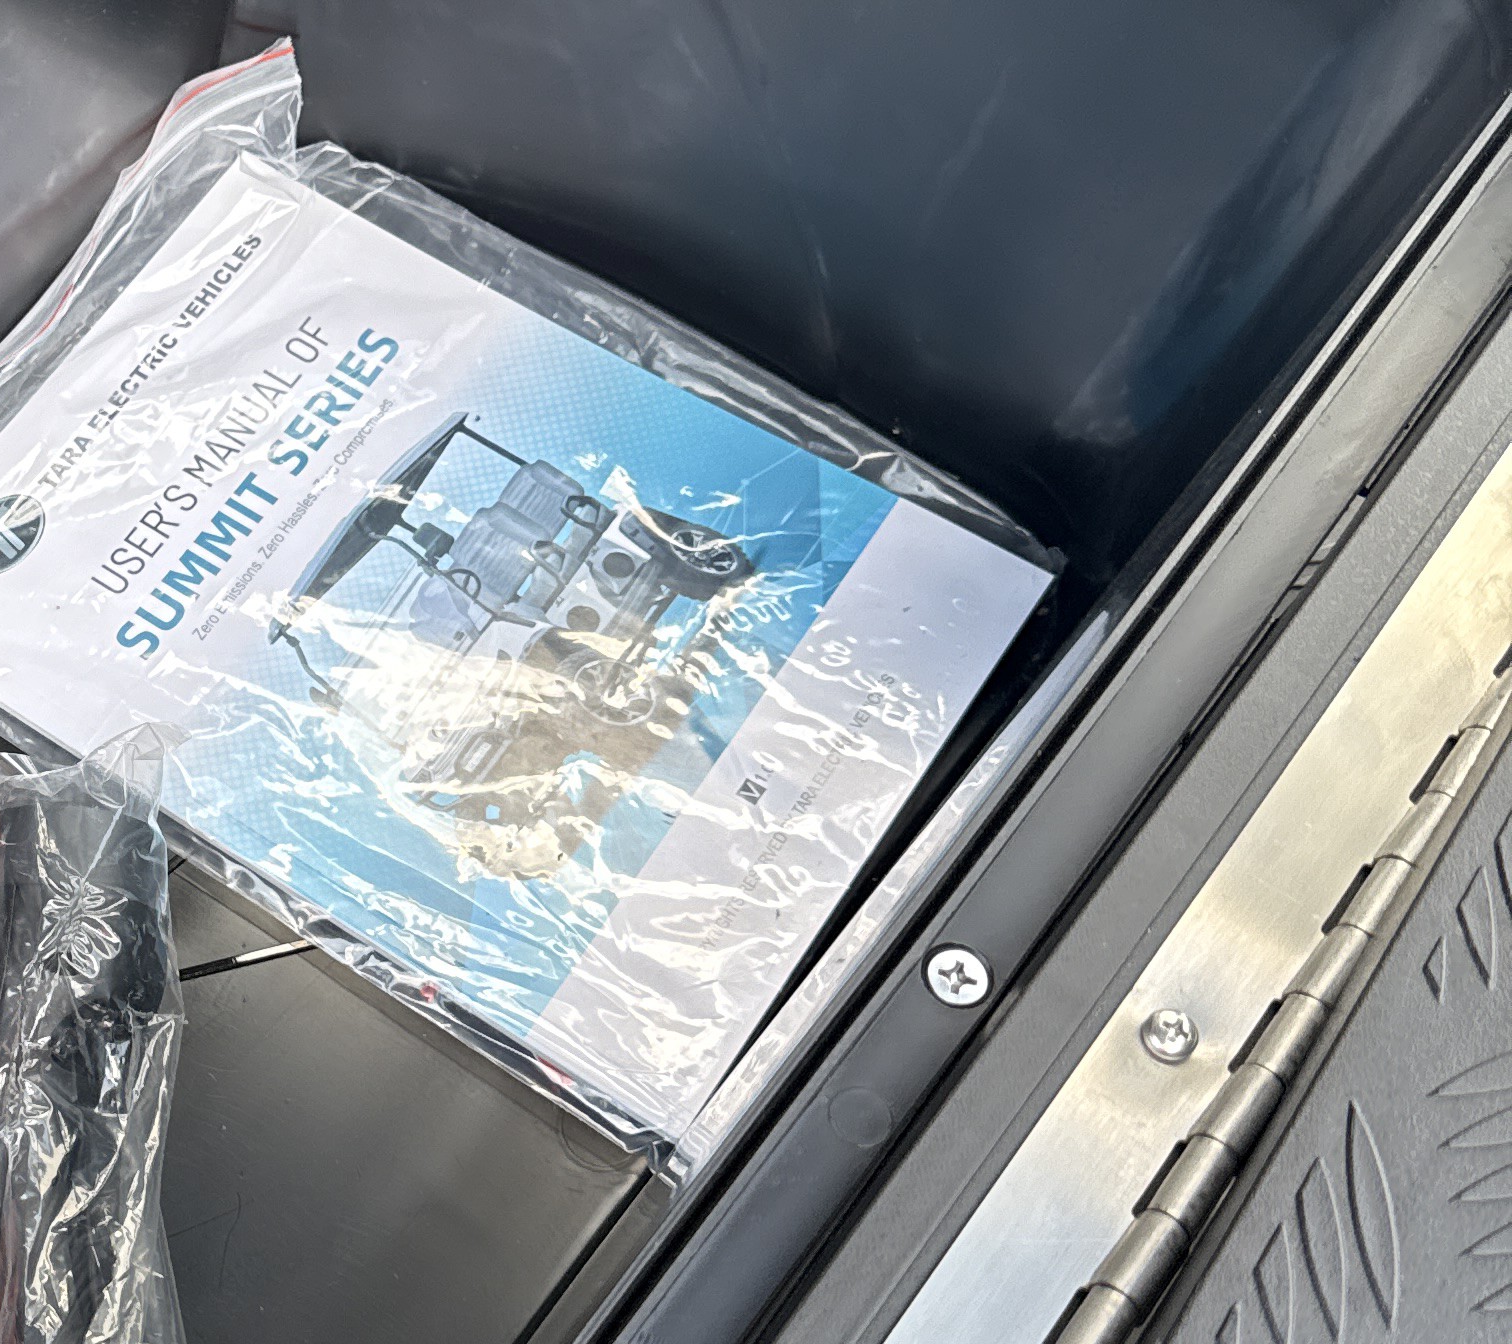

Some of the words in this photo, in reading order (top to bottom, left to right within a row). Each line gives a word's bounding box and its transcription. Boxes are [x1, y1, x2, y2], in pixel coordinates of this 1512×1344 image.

[38, 434, 94, 488] TARA
[88, 333, 178, 433] ELECTRIC
[172, 234, 262, 329] VEHICLES
[91, 484, 198, 594] USER'S
[182, 369, 303, 488] MANUAL
[285, 316, 329, 363] OF
[116, 471, 279, 661] SUMMIT
[268, 328, 399, 477] SERIES
[191, 614, 220, 641] Zero
[257, 533, 285, 560] Zero
[792, 785, 818, 814] TARA
